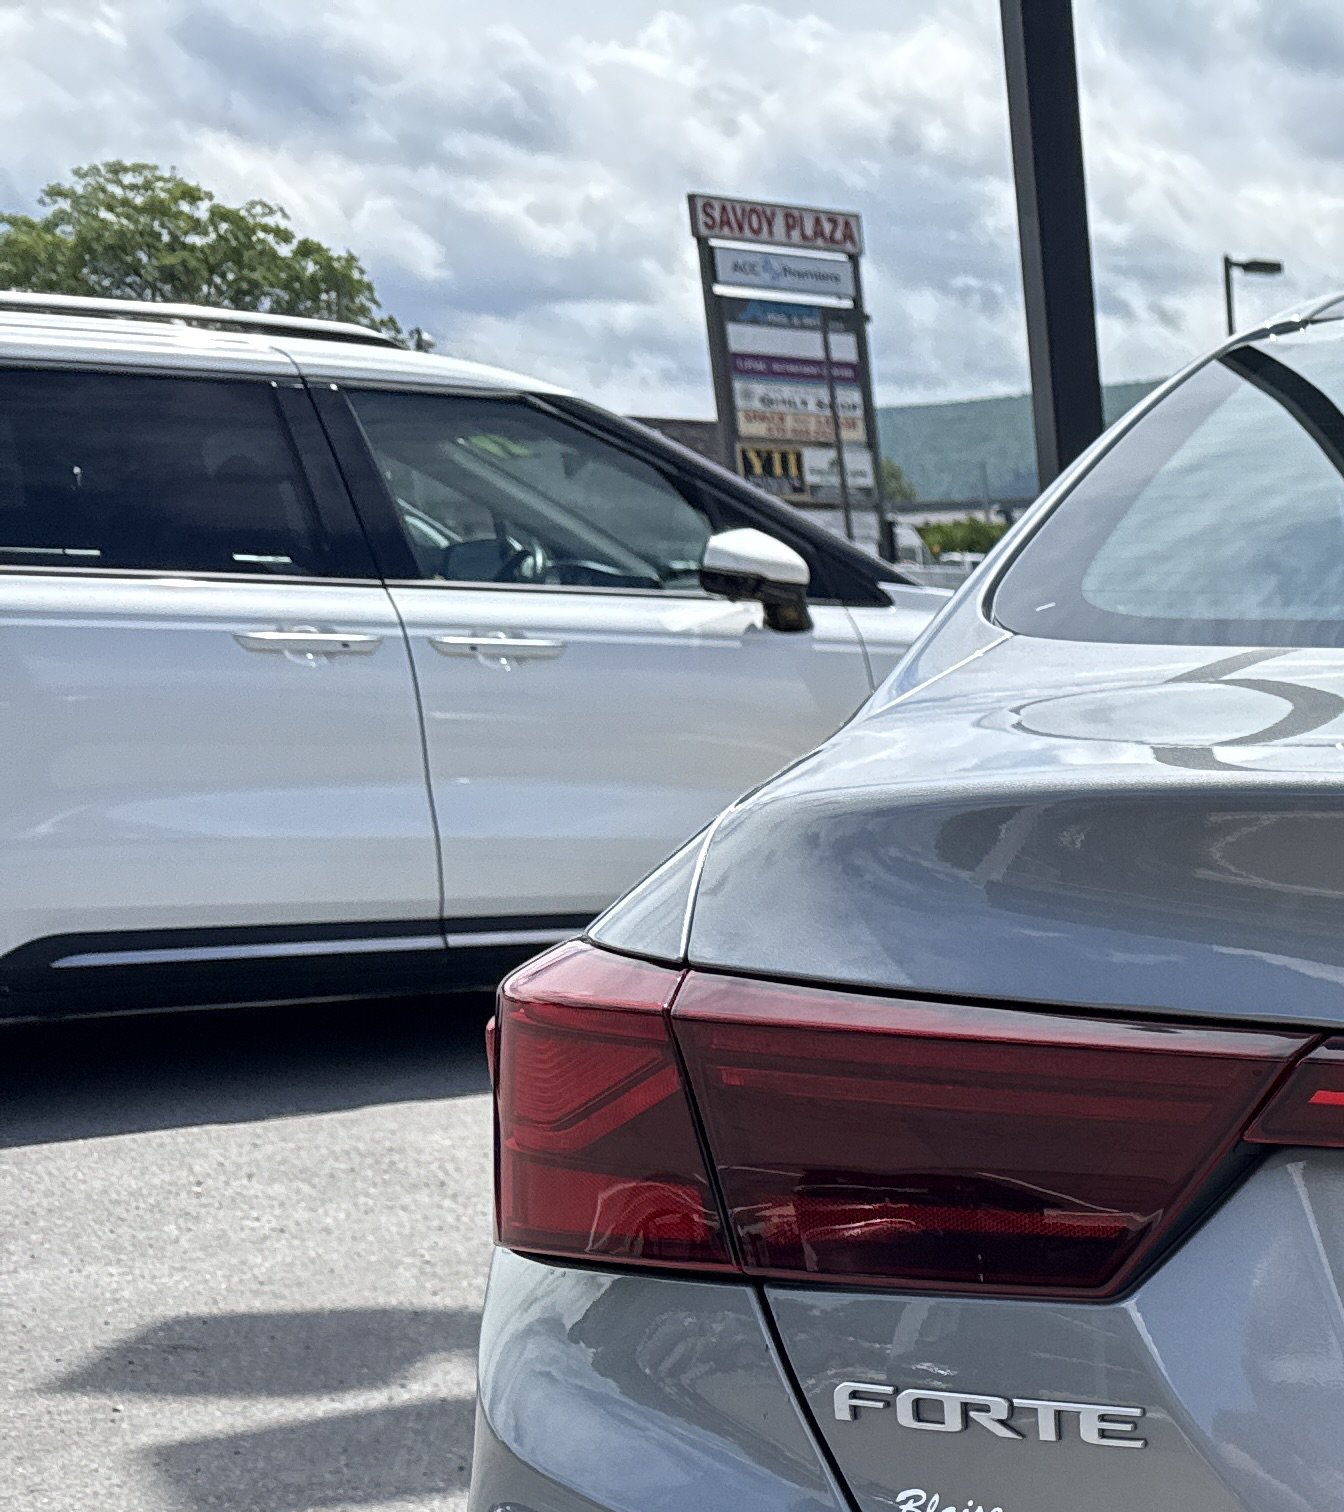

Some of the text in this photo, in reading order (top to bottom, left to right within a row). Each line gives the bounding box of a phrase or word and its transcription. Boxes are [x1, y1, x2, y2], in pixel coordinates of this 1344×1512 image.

[702, 201, 857, 247] SAVOY PLAZA
[834, 1381, 1147, 1449] FORTE
